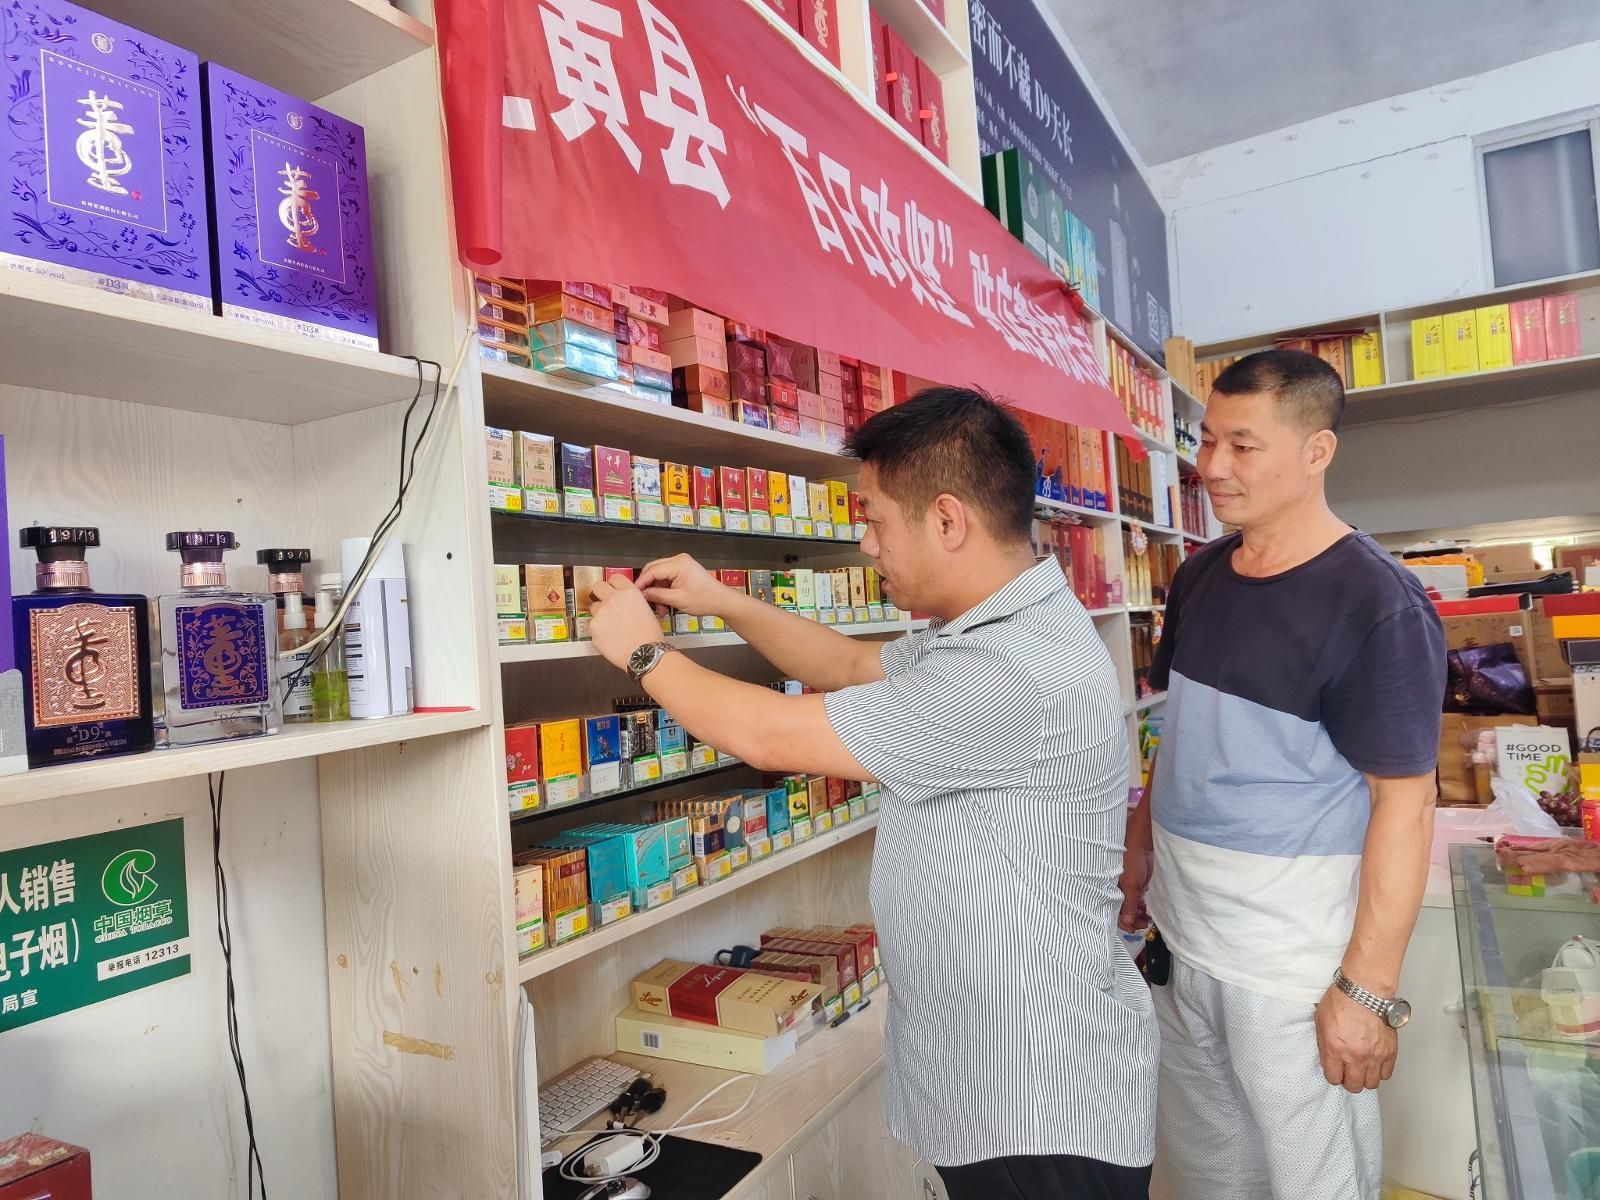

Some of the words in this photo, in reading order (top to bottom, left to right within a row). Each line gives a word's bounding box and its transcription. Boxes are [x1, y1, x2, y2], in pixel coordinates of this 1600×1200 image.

[606, 453, 621, 468] 中华
[507, 497, 520, 507] 100
[545, 500, 557, 510] 100
[580, 503, 592, 513] 100
[48, 529, 96, 543] 1979
[186, 533, 226, 545] 1979
[79, 726, 100, 741] D9
[1506, 744, 1562, 753] #GOOD
[1507, 753, 1542, 762] TIME
[526, 795, 535, 805] 25
[0, 859, 76, 915] 人销售
[94, 899, 172, 935] 中国烟草
[95, 929, 128, 944] CHINA
[130, 917, 173, 935] TOBACCO
[107, 955, 141, 972] 举报电话
[144, 944, 180, 961] 12313
[2, 989, 38, 1014] 局宣
